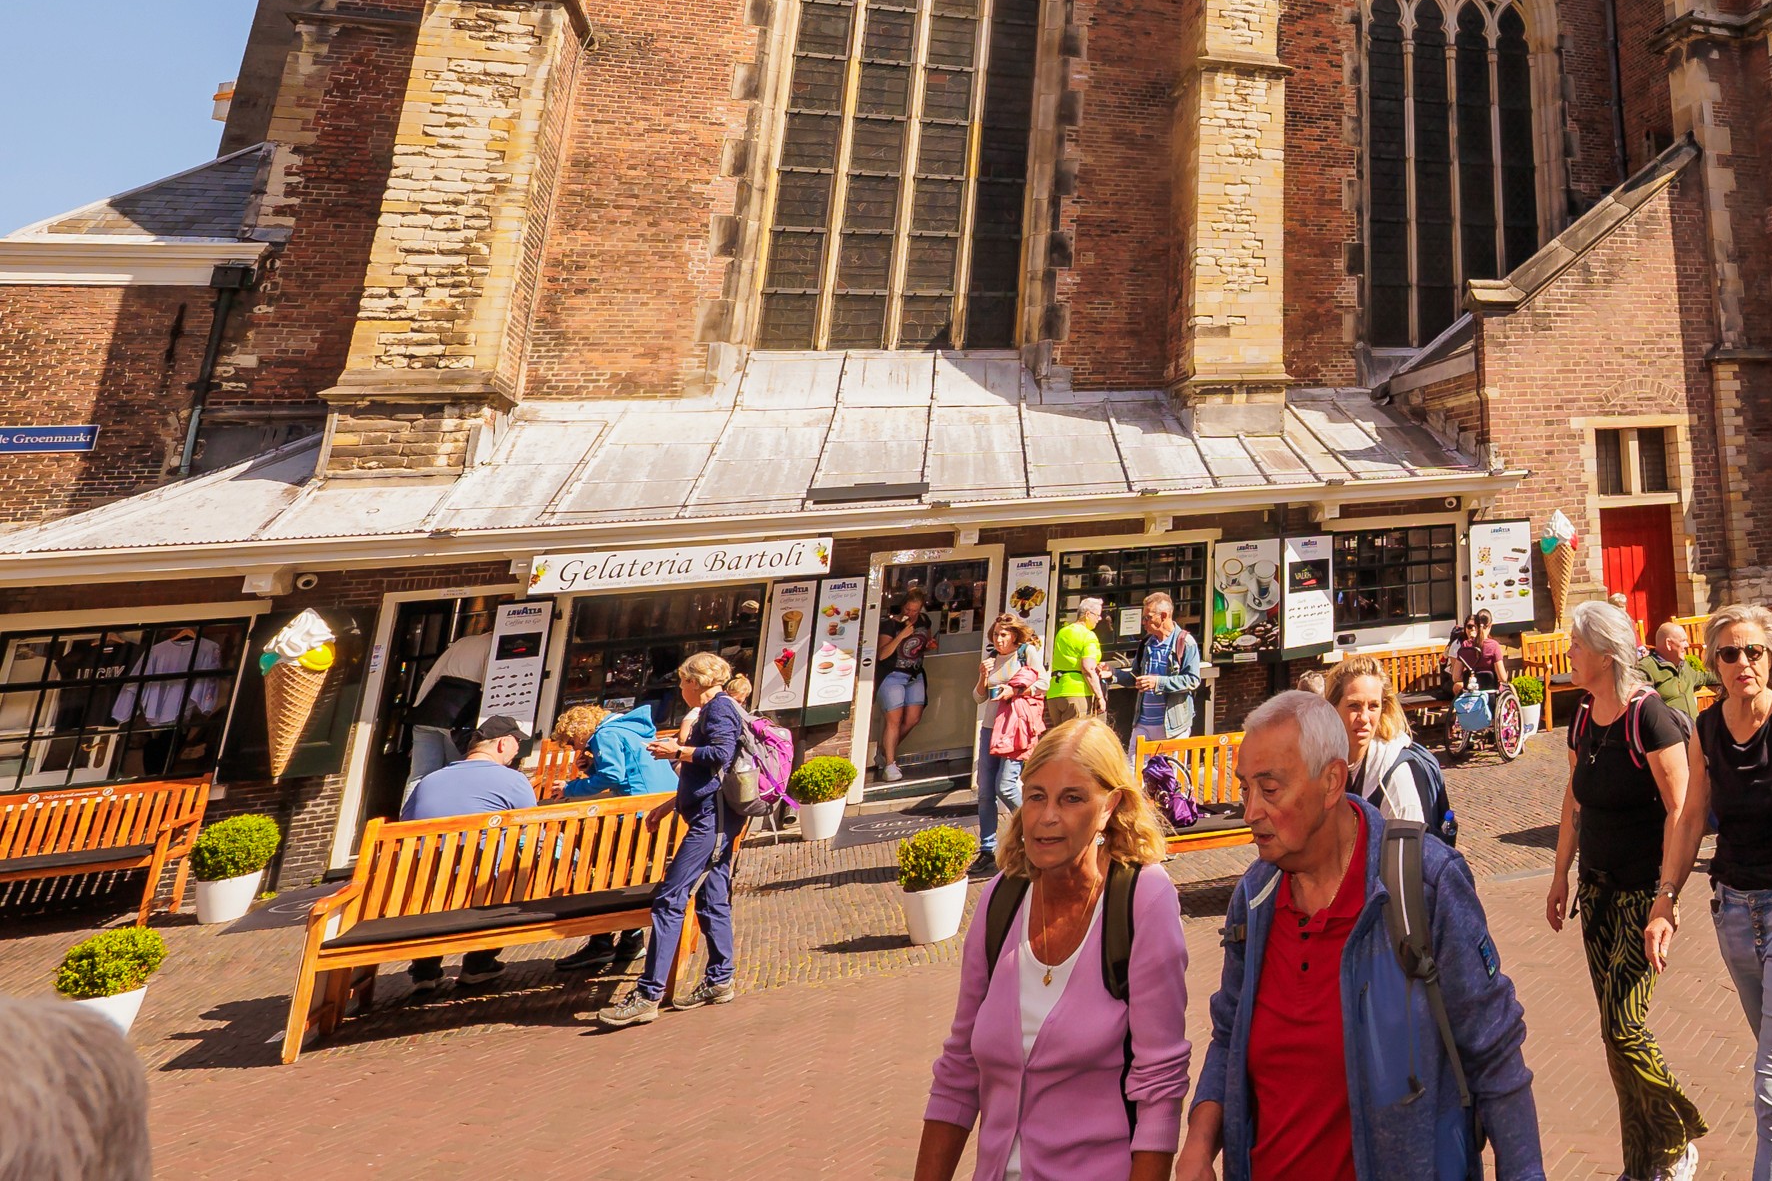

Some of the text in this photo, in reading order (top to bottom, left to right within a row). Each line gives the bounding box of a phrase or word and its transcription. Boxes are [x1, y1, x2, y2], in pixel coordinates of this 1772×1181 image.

[12, 432, 92, 444] Groenmarkt
[559, 542, 806, 590] Gelateria Bartoli
[1016, 560, 1043, 568] LAVAZZA
[781, 585, 809, 594] LAVAZZA
[830, 581, 857, 590] LAVAZZA
[506, 606, 543, 616] LAVAZZA
[504, 619, 524, 627] Coffee
